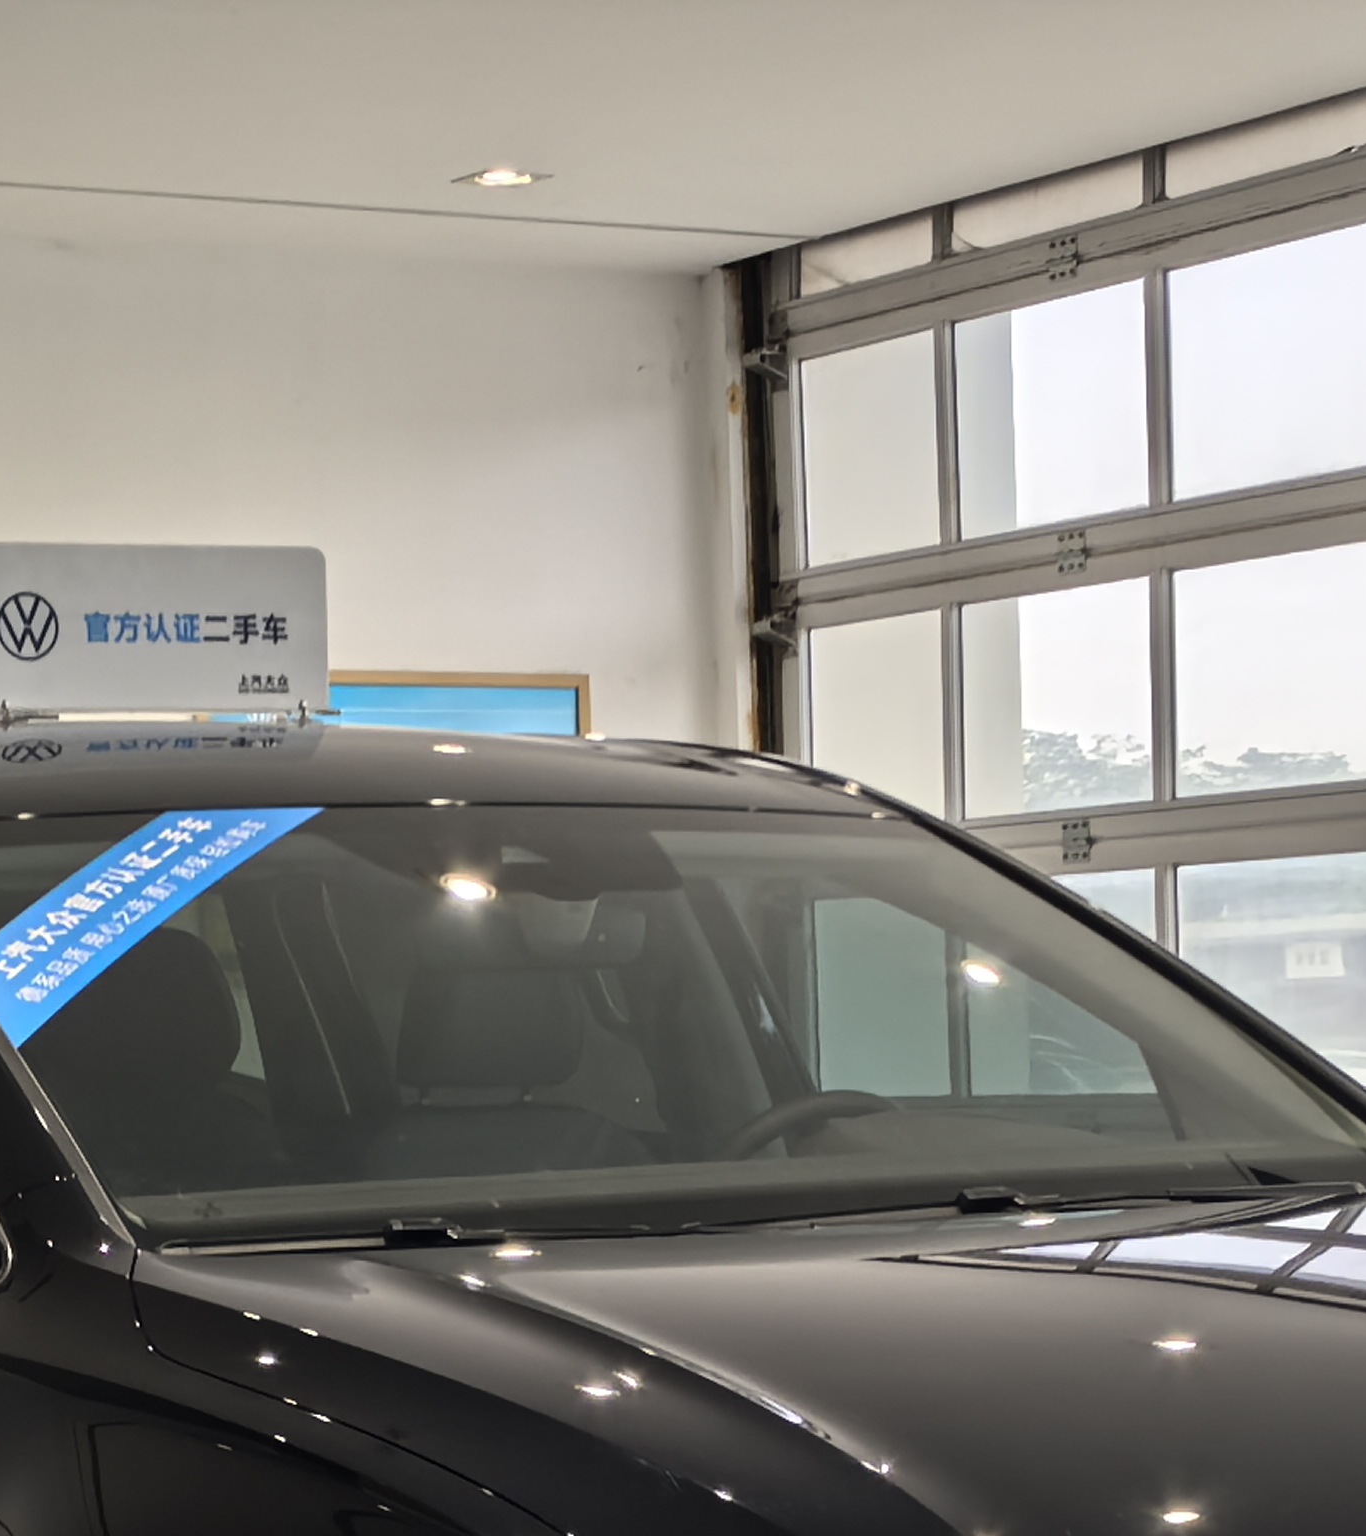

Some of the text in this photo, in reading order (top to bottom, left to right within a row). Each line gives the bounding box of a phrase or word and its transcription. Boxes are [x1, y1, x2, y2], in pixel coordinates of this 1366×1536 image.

[84, 611, 289, 645] 官方认证二手车
